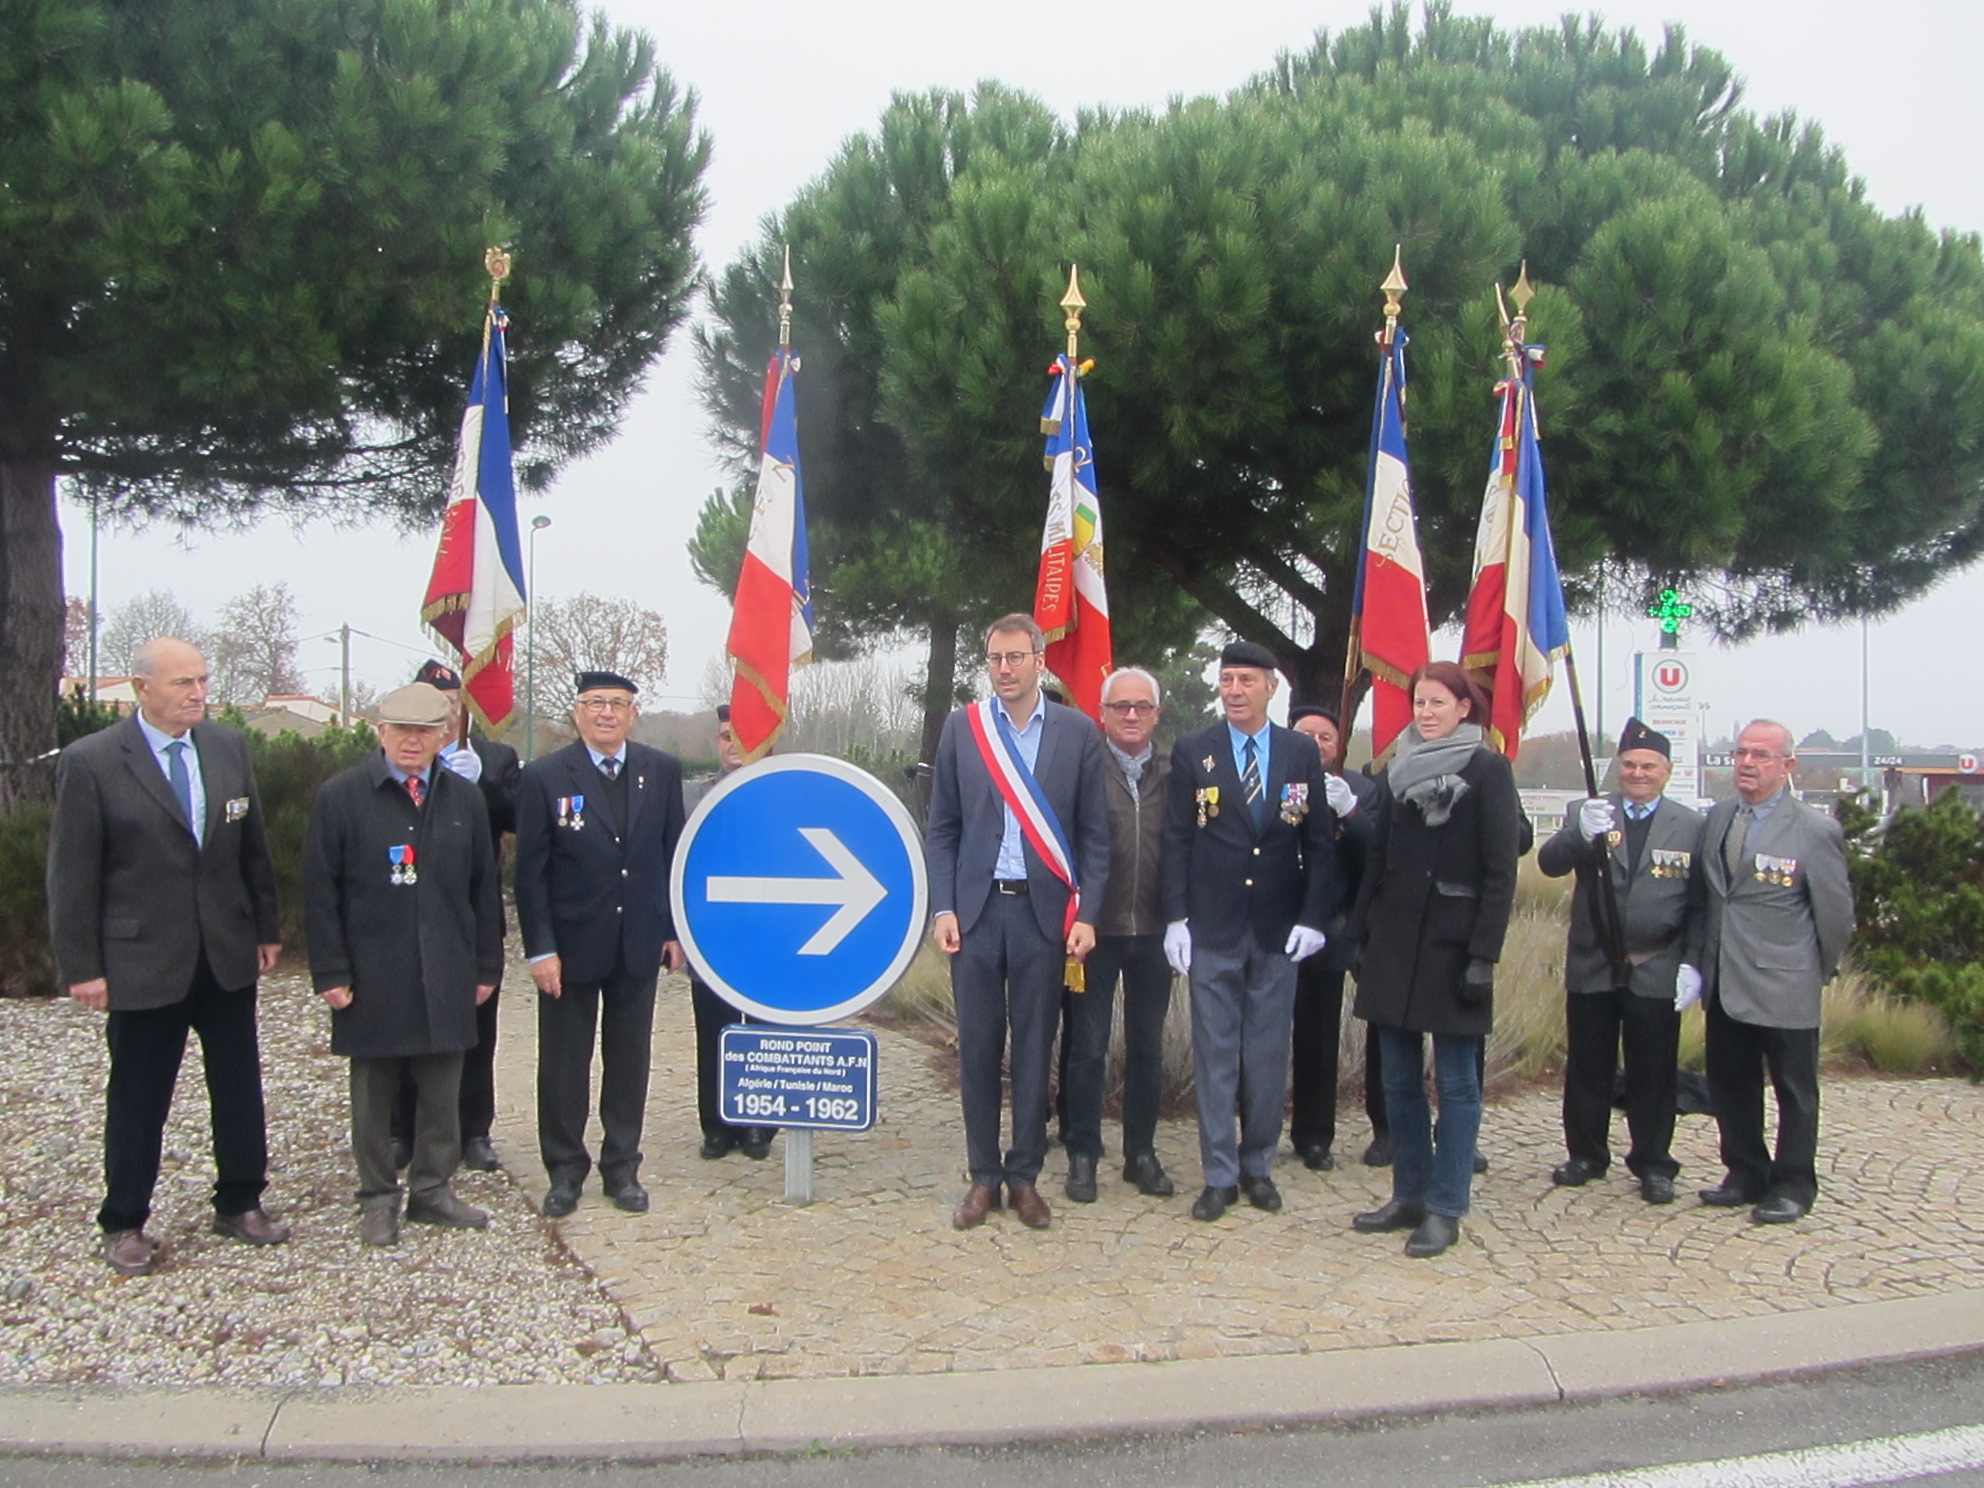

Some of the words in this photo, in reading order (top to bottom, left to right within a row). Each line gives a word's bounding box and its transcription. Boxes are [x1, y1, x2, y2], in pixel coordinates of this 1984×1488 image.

[1660, 668, 1680, 687] U
[1706, 754, 1721, 766] La
[1874, 756, 1903, 765] 24/24
[760, 1039, 794, 1051] ROND
[796, 1041, 832, 1053] POINT
[725, 1052, 745, 1062] des
[747, 1052, 834, 1067] COMBATTANTS
[777, 1065, 811, 1076] Française
[812, 1067, 822, 1075] du
[738, 1078, 772, 1090] Algérie
[780, 1079, 815, 1091] Tunisie
[823, 1082, 853, 1093] Maroc
[733, 1093, 787, 1117] 1954
[805, 1097, 859, 1121] 1962
